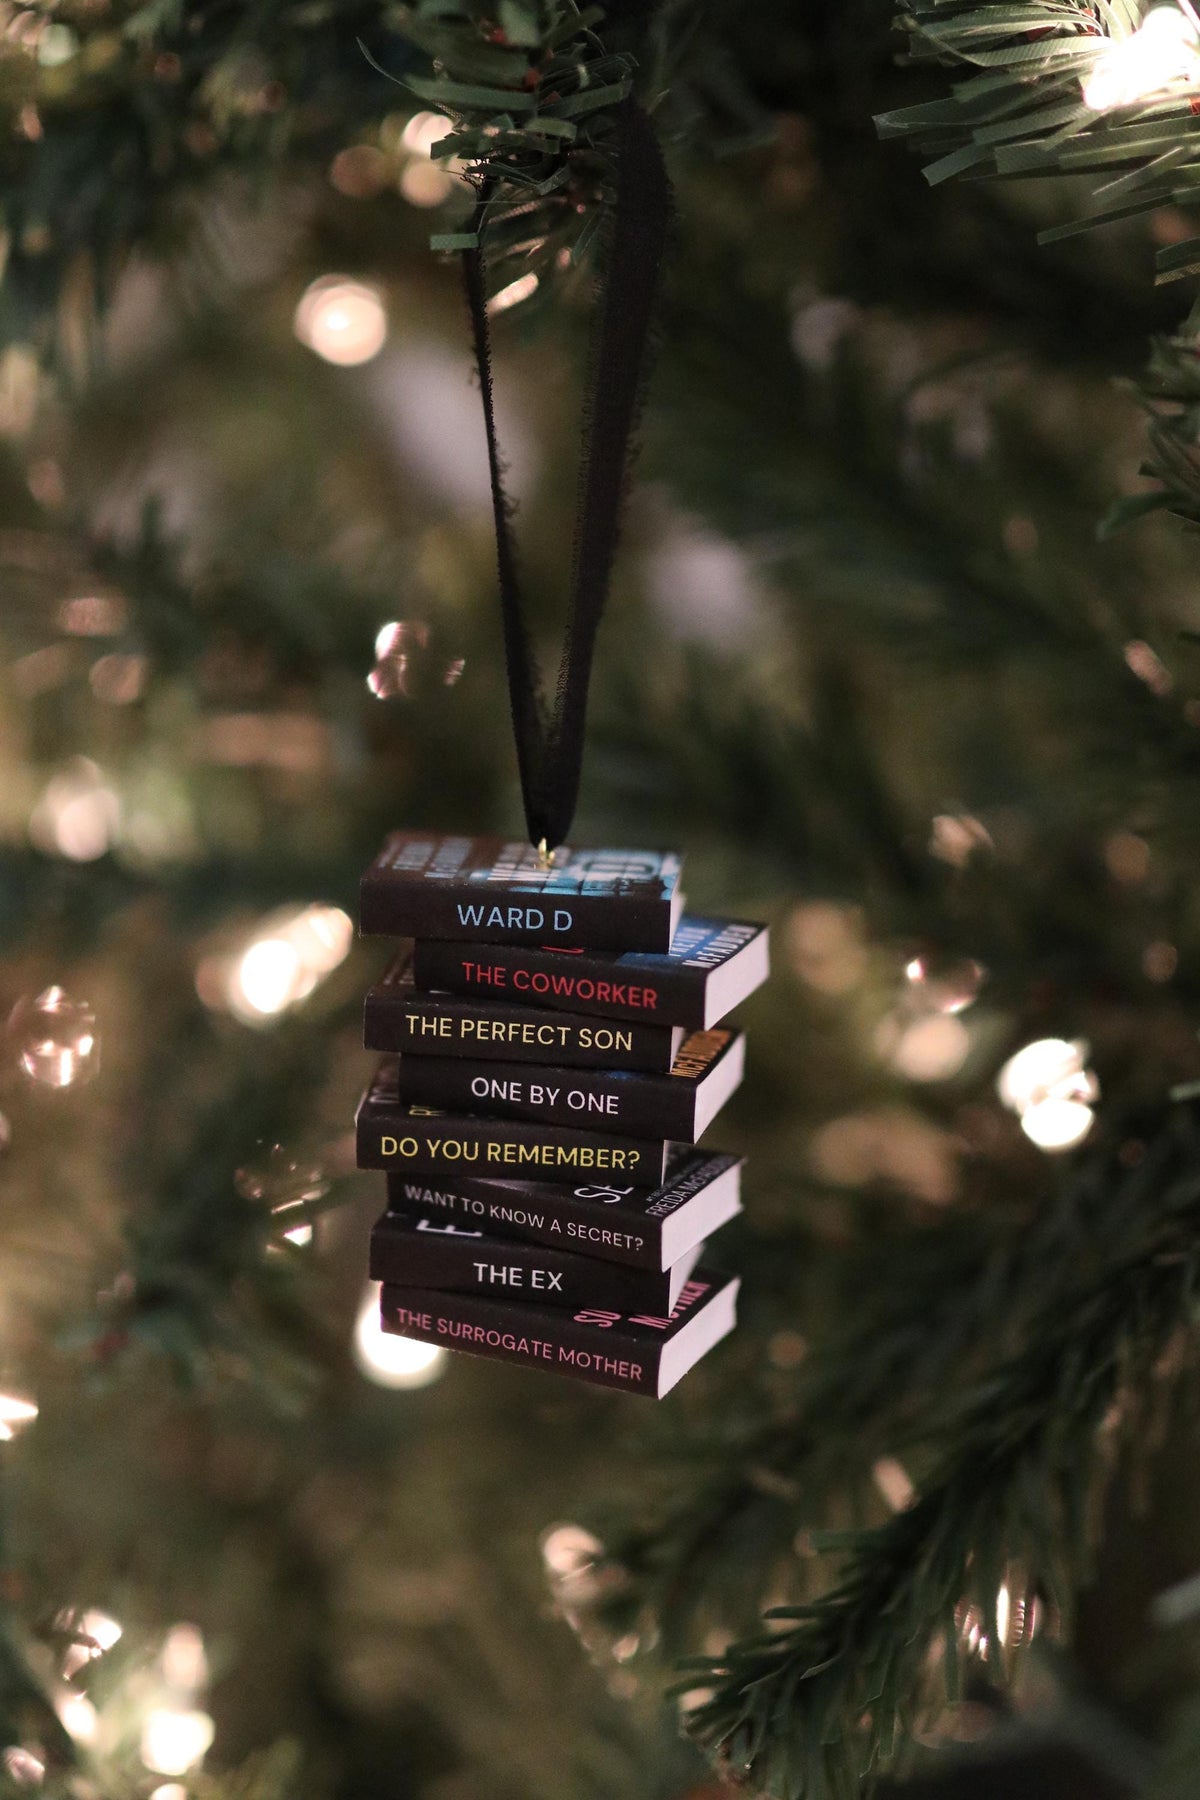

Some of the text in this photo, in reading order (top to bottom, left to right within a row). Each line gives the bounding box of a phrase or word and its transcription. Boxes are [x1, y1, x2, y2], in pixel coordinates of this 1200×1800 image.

[456, 904, 574, 932] WARD D
[461, 961, 658, 1010] THE COWORKER
[405, 1014, 634, 1052] THE PERFECT SON
[470, 1076, 620, 1116] ONE BY ONE
[380, 1135, 642, 1171] DO YOU REMEMBER?
[404, 1184, 458, 1209] WANT
[460, 1196, 486, 1216] TO
[489, 1204, 546, 1229] KNOW
[549, 1218, 563, 1234] A
[566, 1222, 645, 1252] SECRET?
[644, 1189, 692, 1218] FREIDA
[472, 1262, 564, 1292] THE EX
[396, 1307, 433, 1331] THE
[436, 1318, 553, 1360] SURROGATE
[557, 1346, 643, 1382] MOTHER
